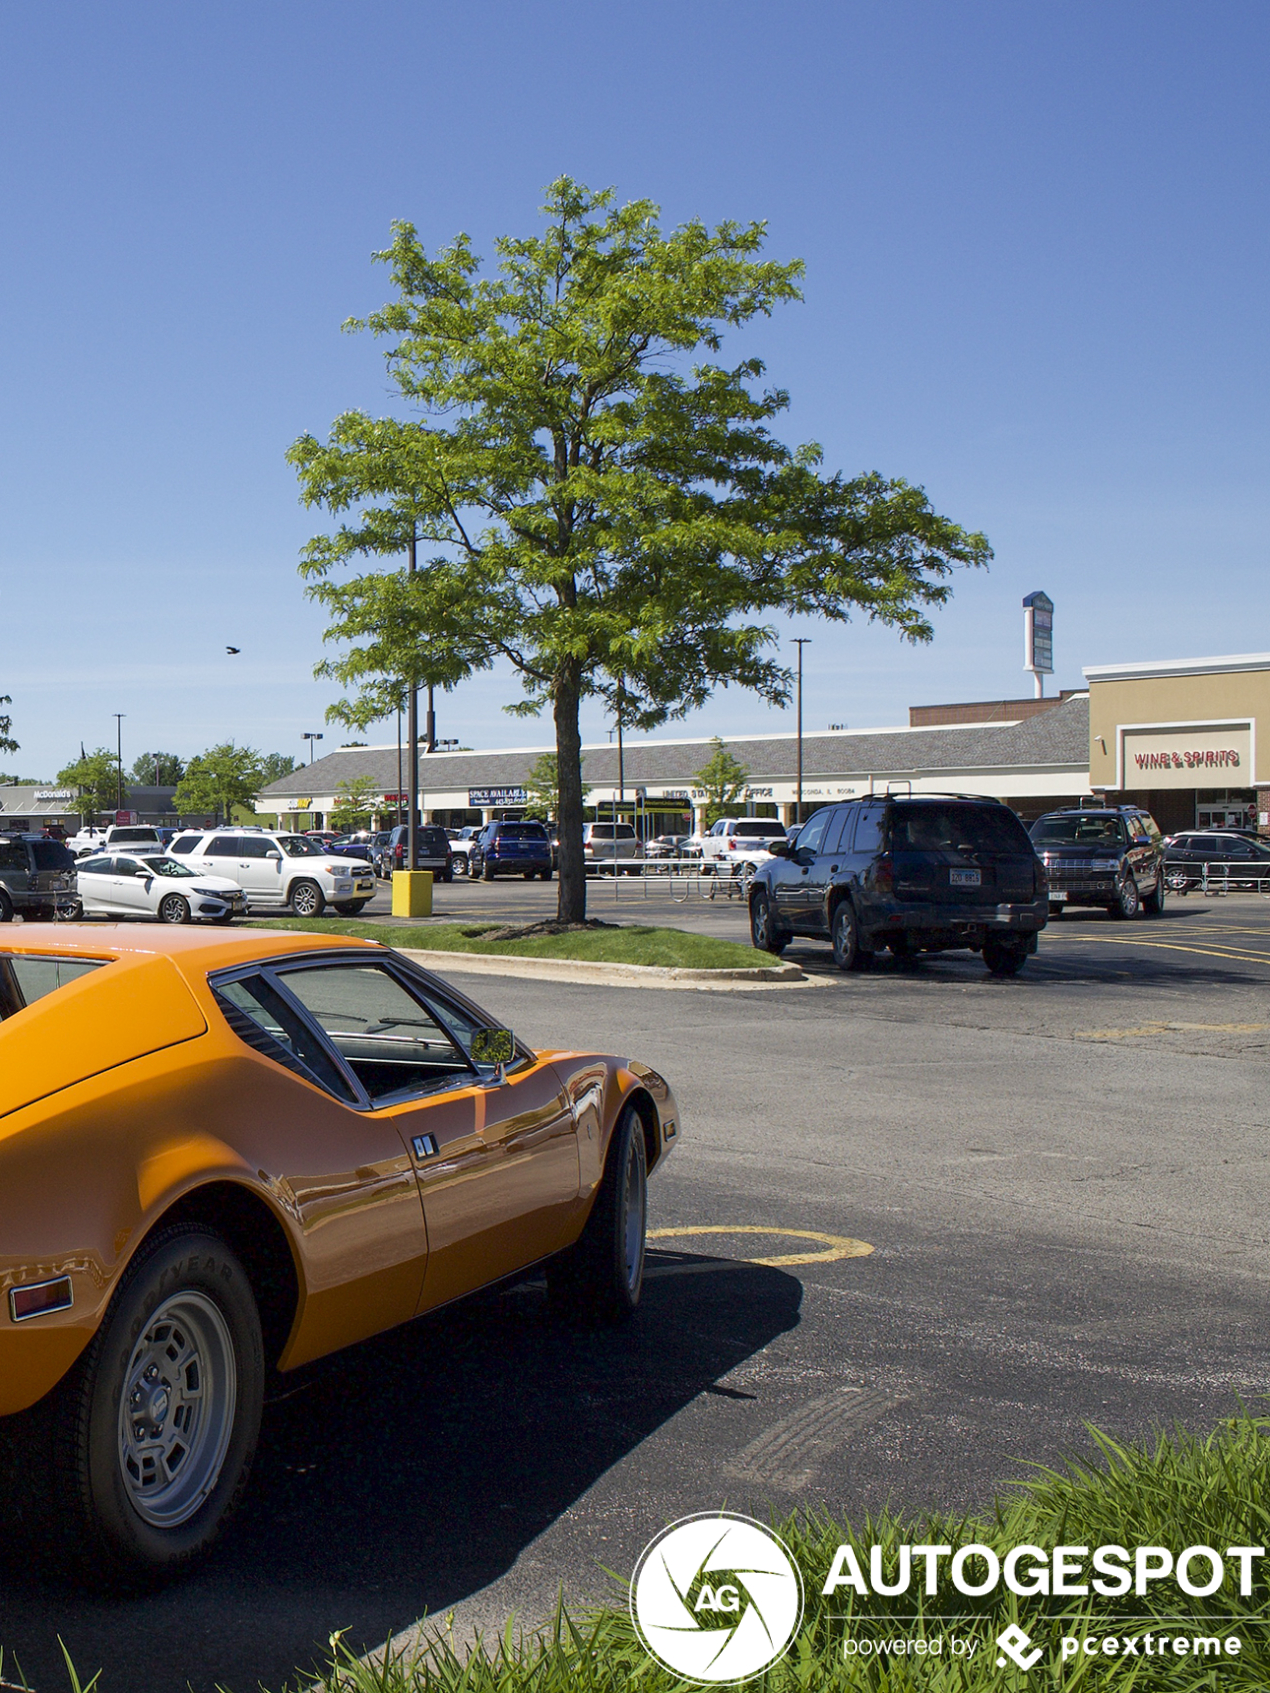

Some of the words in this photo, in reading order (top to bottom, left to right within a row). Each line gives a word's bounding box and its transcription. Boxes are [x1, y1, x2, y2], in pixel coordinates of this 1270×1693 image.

[1134, 752, 1168, 765] WINE
[1171, 752, 1181, 763] &
[1183, 750, 1238, 763] SPIRITS
[33, 790, 71, 799] McDonald's
[469, 790, 489, 798] SPACE
[490, 789, 527, 797] AVAILABLE
